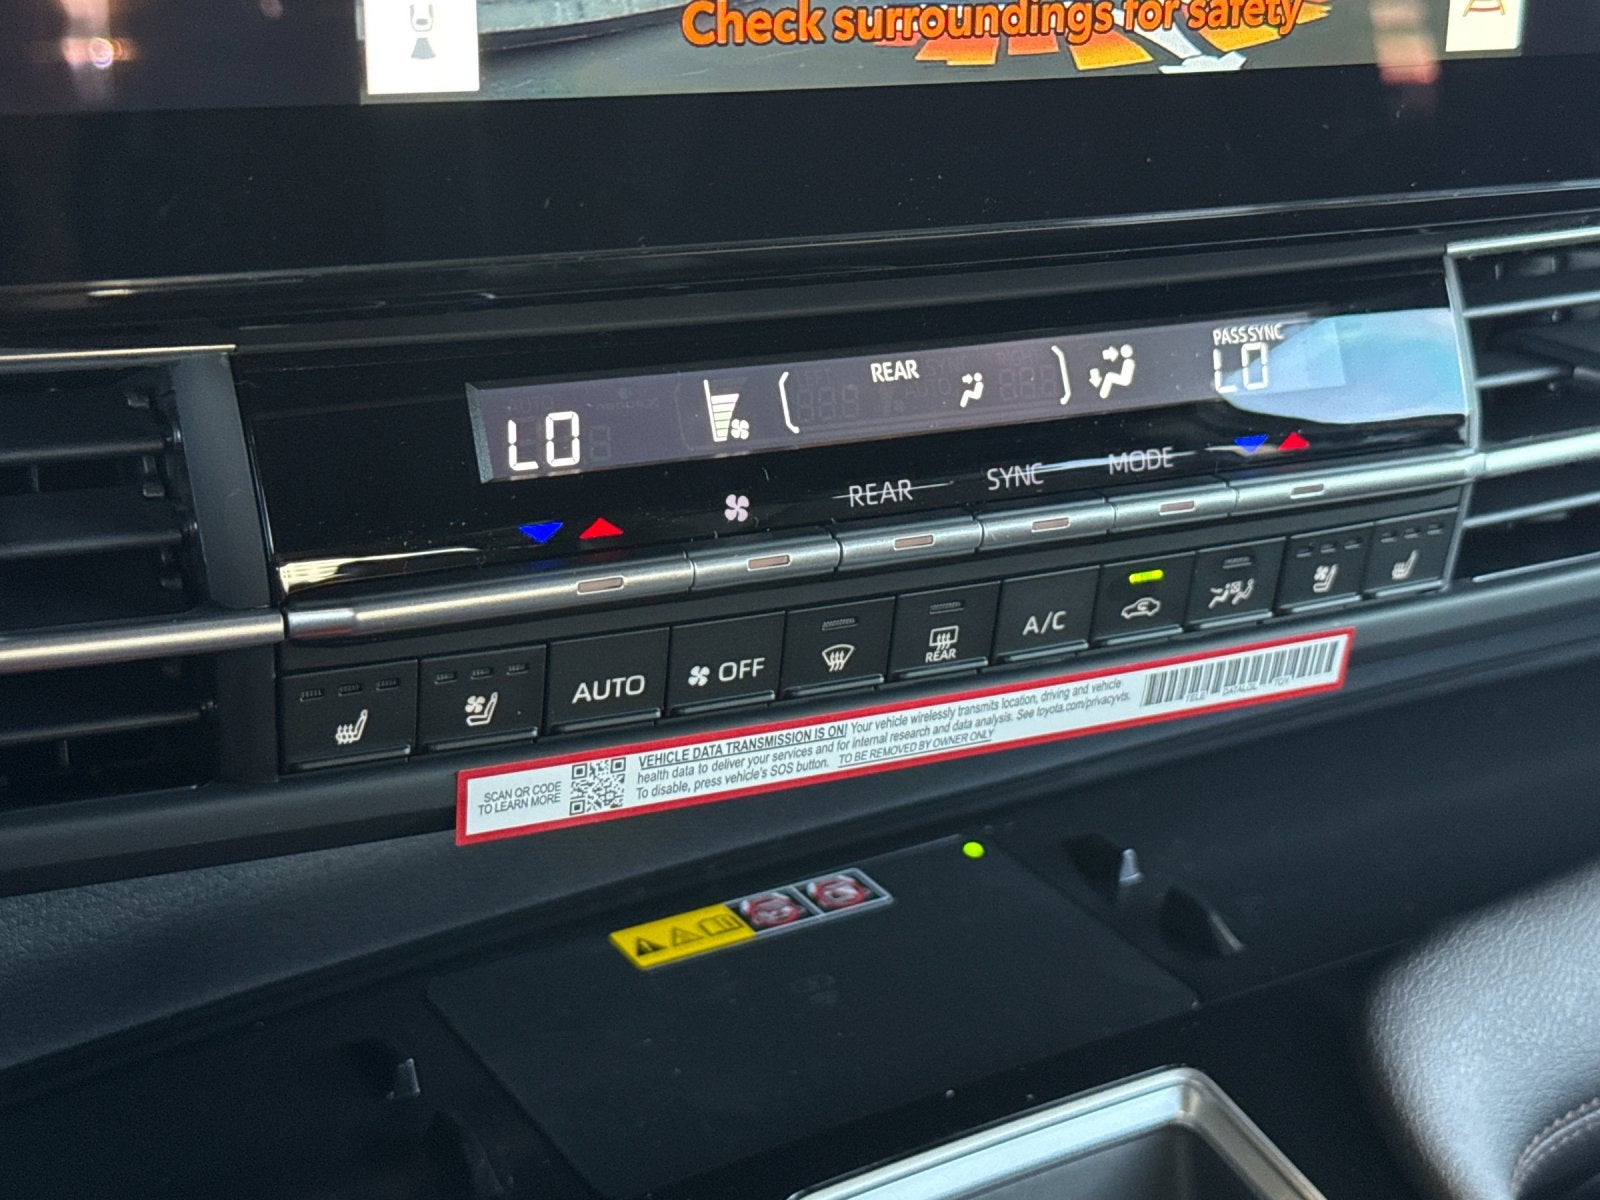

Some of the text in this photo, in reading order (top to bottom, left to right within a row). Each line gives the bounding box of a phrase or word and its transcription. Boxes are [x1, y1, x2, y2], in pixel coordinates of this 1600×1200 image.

[681, 0, 1302, 46] Check surroundings for safety
[1213, 323, 1285, 346] PASS SYNC
[870, 359, 920, 383] REAR
[1213, 341, 1268, 393] LO
[508, 410, 580, 470] LO
[1108, 446, 1175, 475] MODE
[986, 462, 1044, 490] SYNC
[848, 479, 914, 508] REAR
[1022, 610, 1067, 636] A/C
[718, 657, 766, 682] OFF
[925, 647, 957, 663] REAR
[571, 674, 646, 704] AUTO
[638, 678, 1122, 768] VEHICLE DATA TRANSMISSION IS ON! Your vehicle wirelessly transmits location, driving and vehicle
[637, 766, 669, 785] health
[672, 764, 695, 780] data
[699, 762, 709, 775] to
[711, 756, 745, 772] deliver
[747, 753, 770, 768] your
[771, 746, 813, 762] services
[815, 741, 835, 754] and
[836, 738, 851, 752] for
[852, 732, 888, 748] internal
[890, 726, 931, 741] research
[932, 722, 951, 734] and
[952, 719, 973, 731] data
[1016, 708, 1035, 722] See
[839, 728, 995, 765] TO BE REMOVED BY OWNER ONLY
[483, 781, 562, 803] SCAN QR CODE
[636, 757, 830, 799] To disable, press vehicle's SOS button.
[478, 792, 561, 815] TO LEARN MORE
